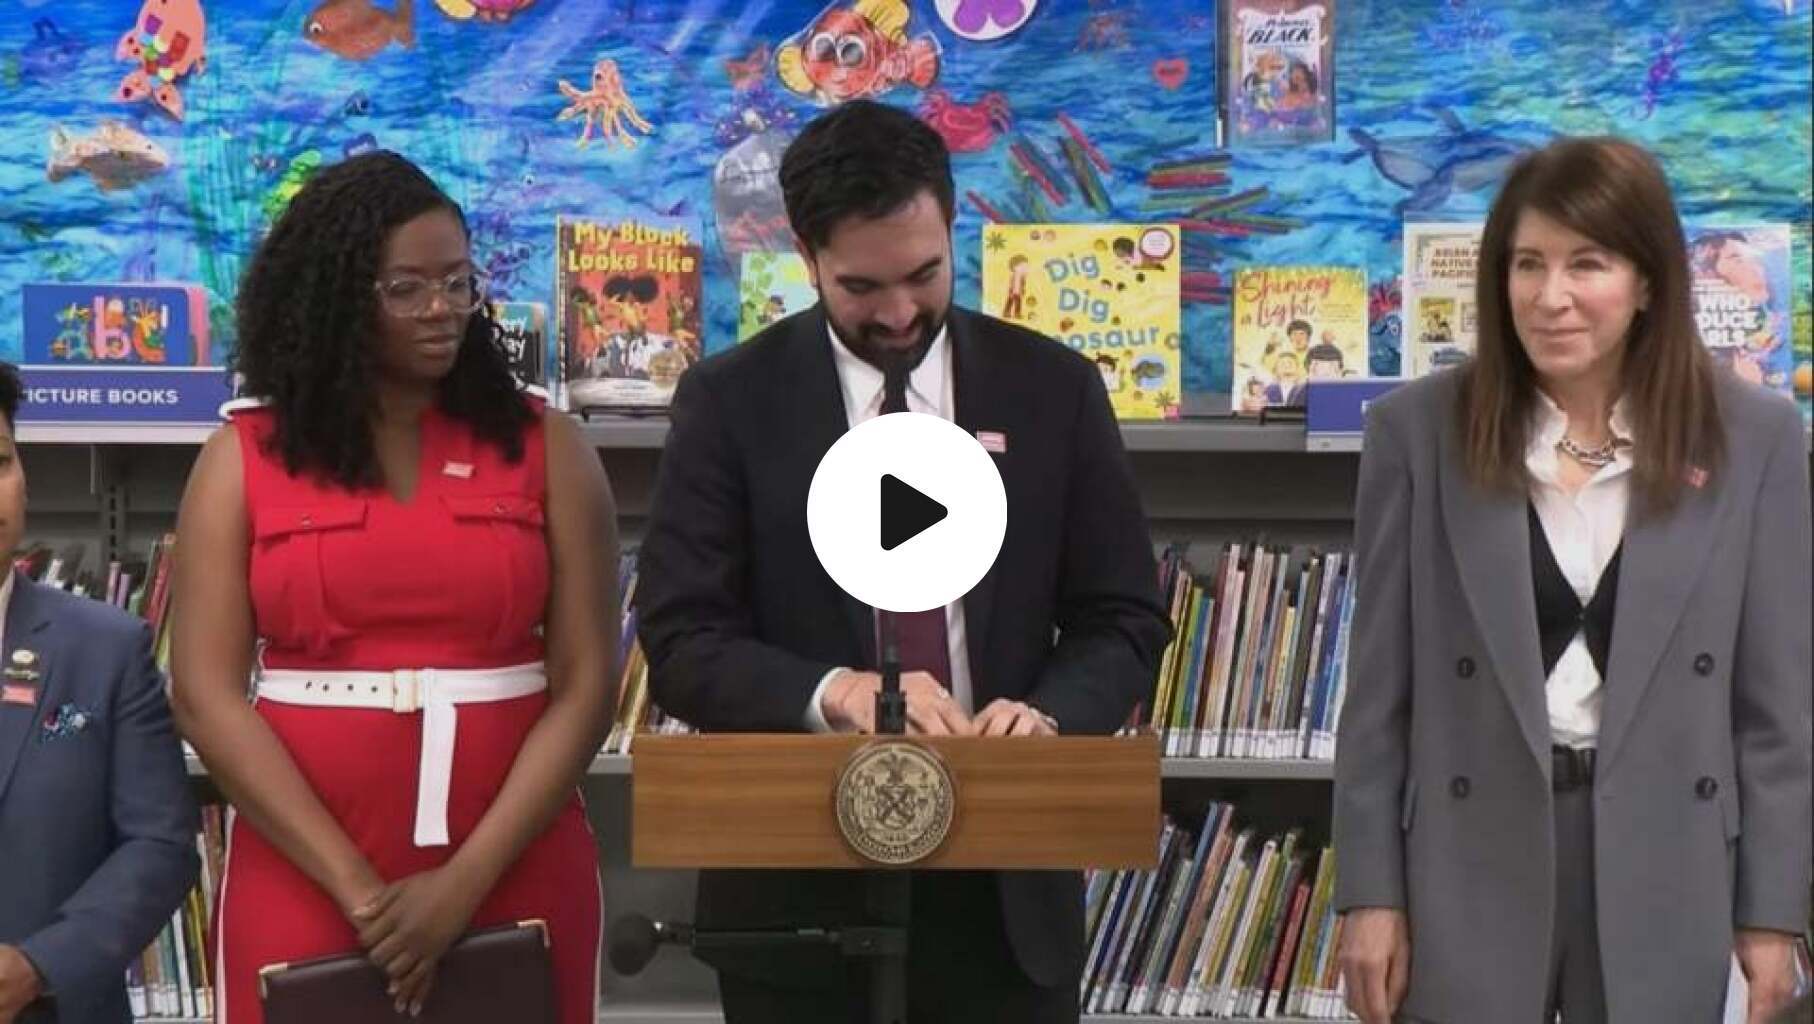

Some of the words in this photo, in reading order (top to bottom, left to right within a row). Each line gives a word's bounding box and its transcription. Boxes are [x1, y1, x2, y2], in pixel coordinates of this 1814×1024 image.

[574, 222, 612, 249] My
[621, 222, 690, 247] Block
[569, 249, 638, 272] Looks
[647, 250, 696, 273] Like
[1045, 255, 1100, 283] Dig
[1431, 259, 1473, 268] NATIVE
[1059, 288, 1110, 324] Dig
[108, 388, 179, 404] BOOKS
